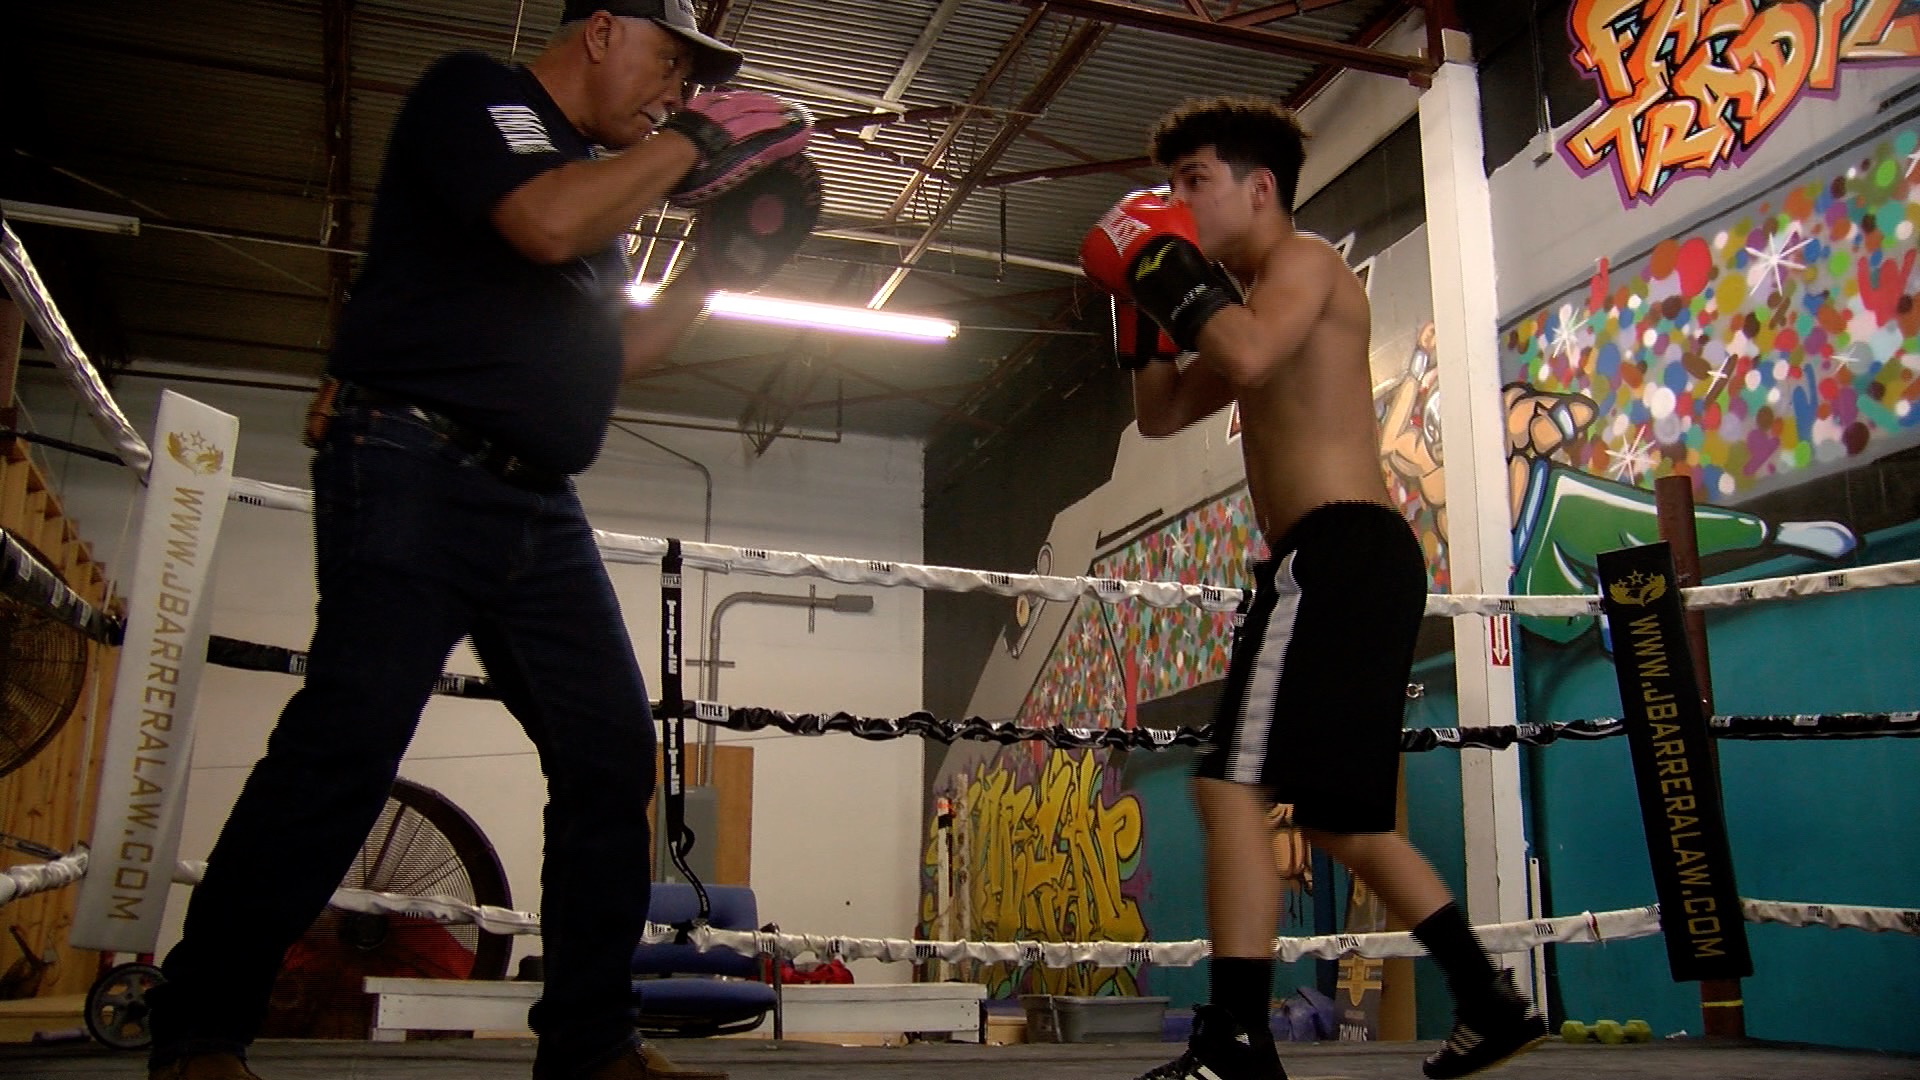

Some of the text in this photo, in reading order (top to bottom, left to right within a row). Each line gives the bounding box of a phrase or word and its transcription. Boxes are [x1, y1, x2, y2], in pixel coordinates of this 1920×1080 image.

[666, 599, 678, 675] TITLE
[107, 487, 205, 922] WWW.JBARRERALAW.COM
[701, 703, 725, 718] TITLE
[667, 717, 681, 796] TITLE
[1629, 614, 1725, 959] WWW.JBARRERALAW.COM
